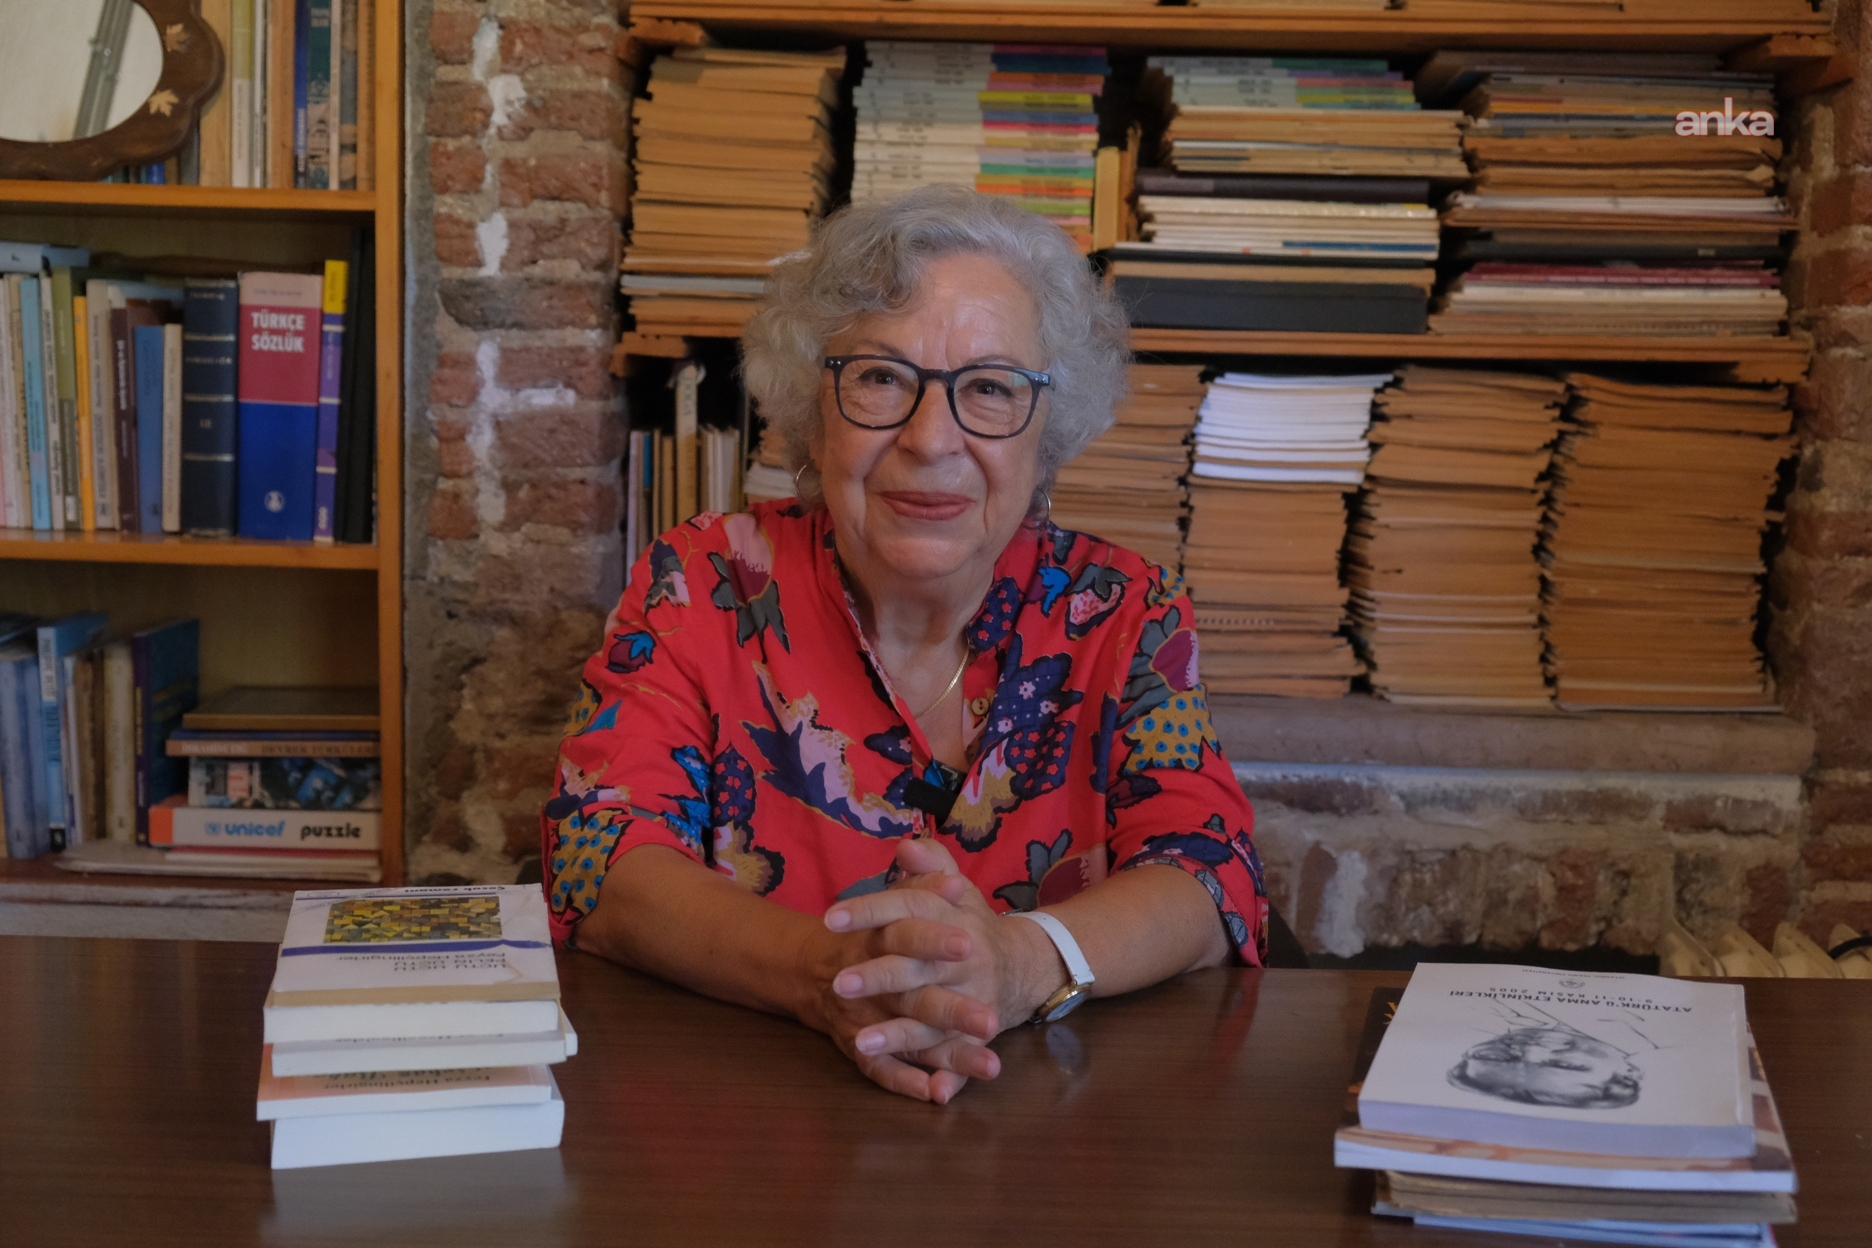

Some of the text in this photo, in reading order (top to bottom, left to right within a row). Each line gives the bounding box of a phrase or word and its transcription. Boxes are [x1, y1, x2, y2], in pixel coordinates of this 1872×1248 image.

[251, 308, 305, 331] TÜRKÇE
[251, 331, 305, 353] SÖZLÜK
[224, 820, 362, 840] unicef puzzle
[1449, 990, 1551, 1002] ETKİNLİKLERİ
[1557, 996, 1601, 1006] ANMA
